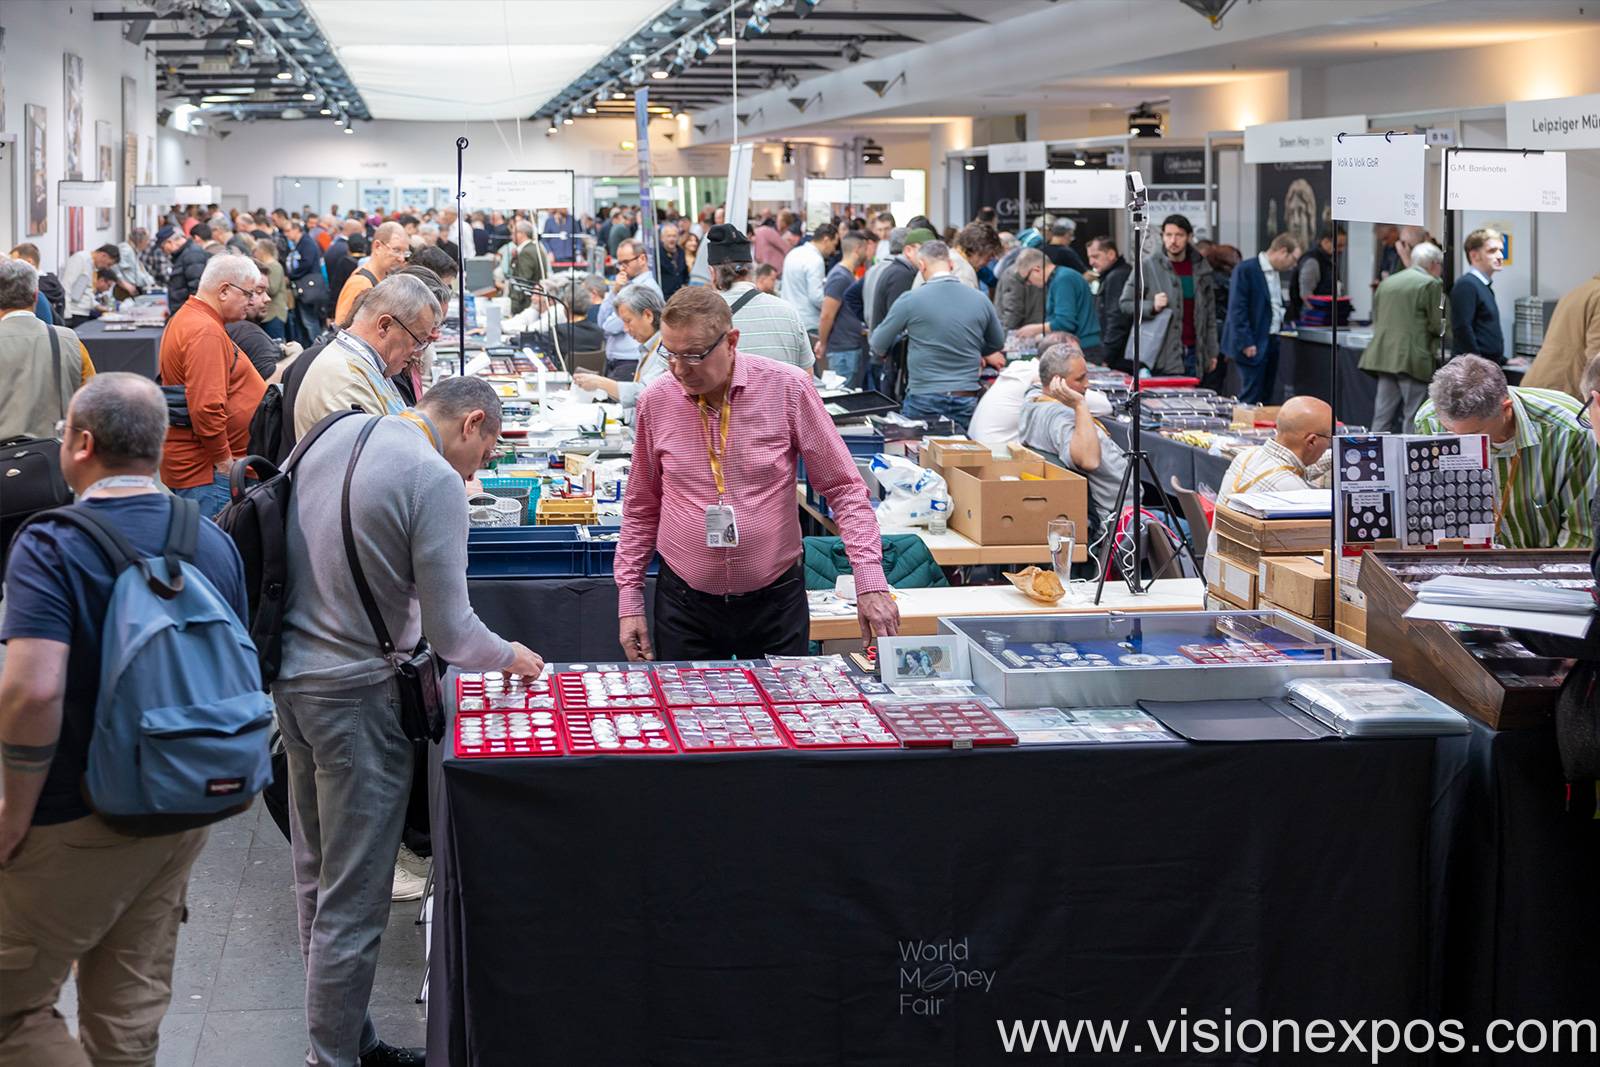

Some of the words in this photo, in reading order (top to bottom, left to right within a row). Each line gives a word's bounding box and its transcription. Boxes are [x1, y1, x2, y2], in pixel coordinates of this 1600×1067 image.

[1532, 117, 1578, 135] Leipziger
[1337, 157, 1348, 167] Volk
[1354, 157, 1366, 167] Volk
[1468, 164, 1507, 173] Banknotes
[898, 937, 969, 962] World
[900, 963, 996, 993] Money
[900, 993, 945, 1016] Fair
